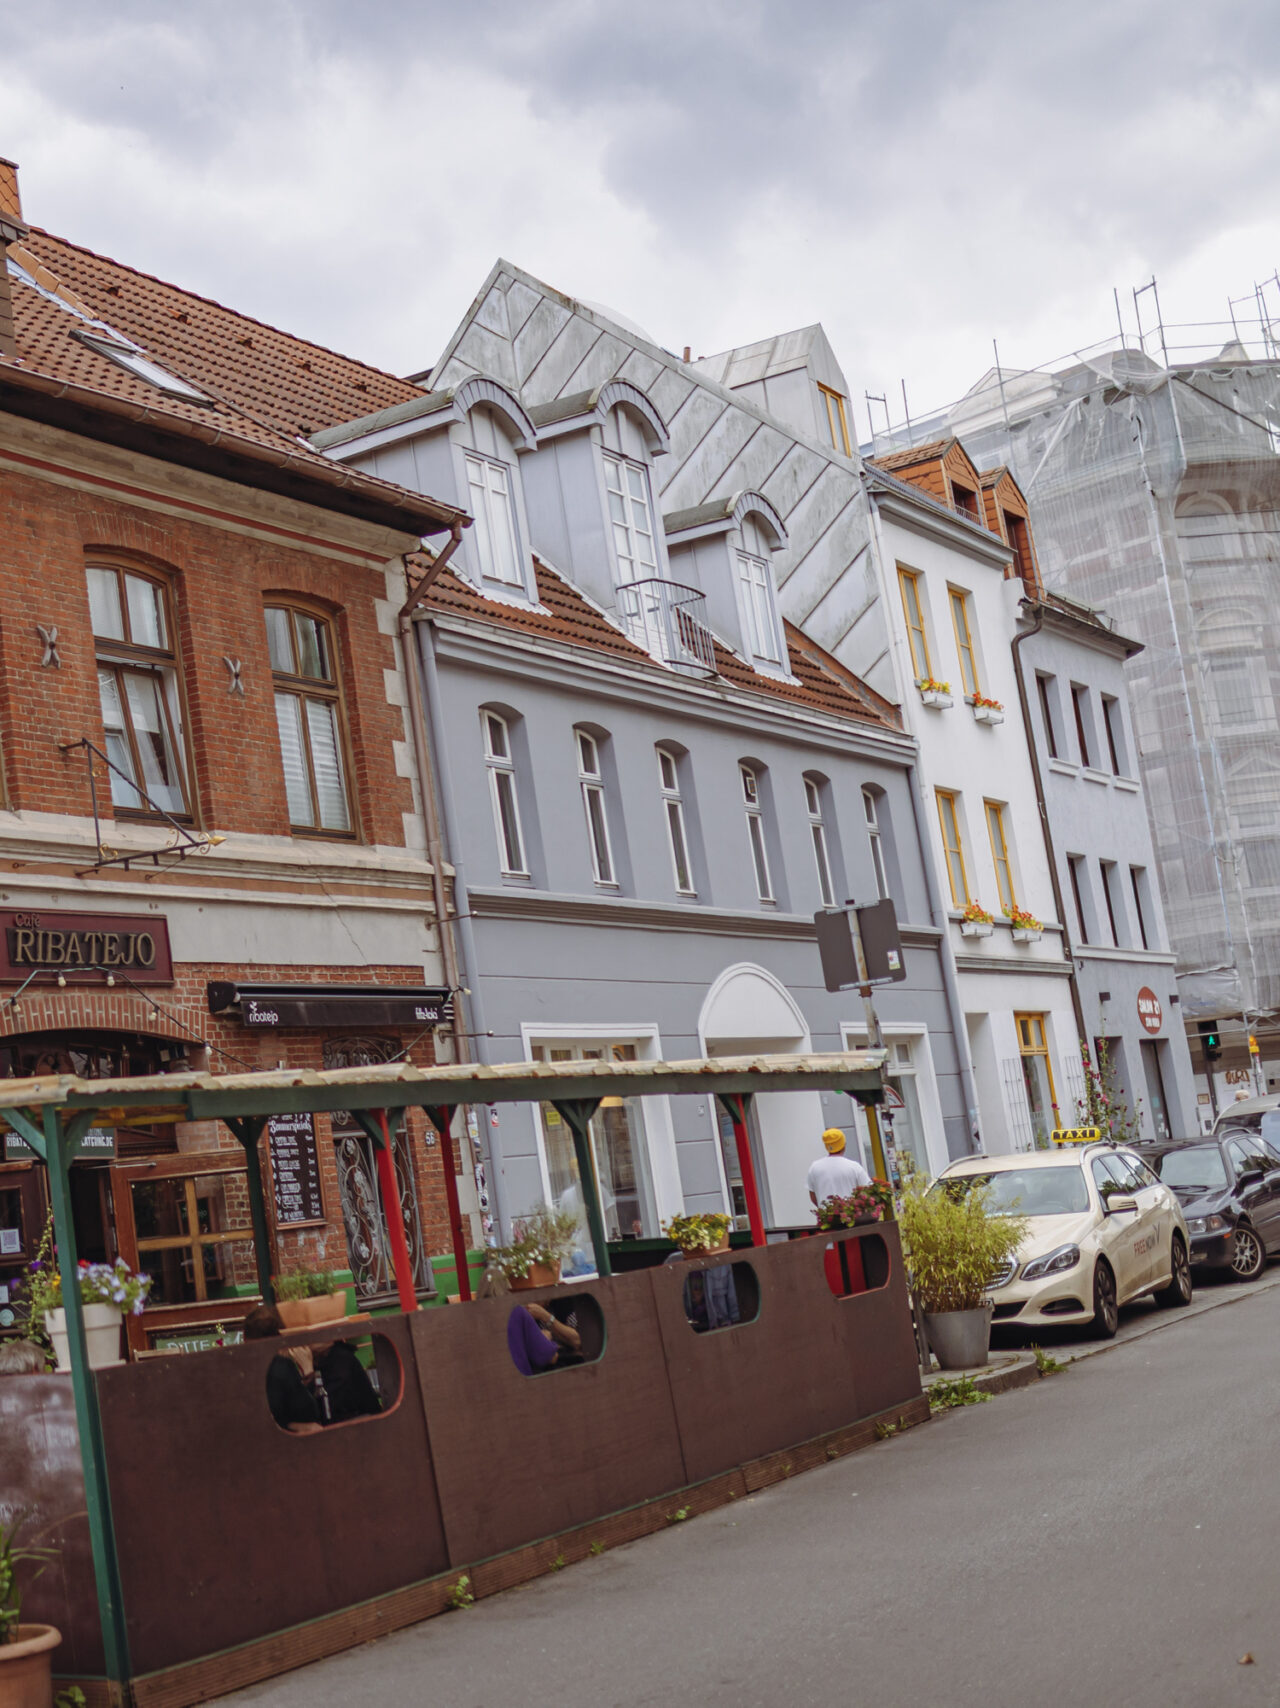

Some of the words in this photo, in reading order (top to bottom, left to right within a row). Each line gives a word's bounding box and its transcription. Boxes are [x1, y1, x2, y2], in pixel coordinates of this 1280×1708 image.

[15, 913, 40, 930] Café
[15, 929, 156, 966] RIBATEJO
[425, 1131, 435, 1145] 56
[1057, 1129, 1091, 1139] TAXI
